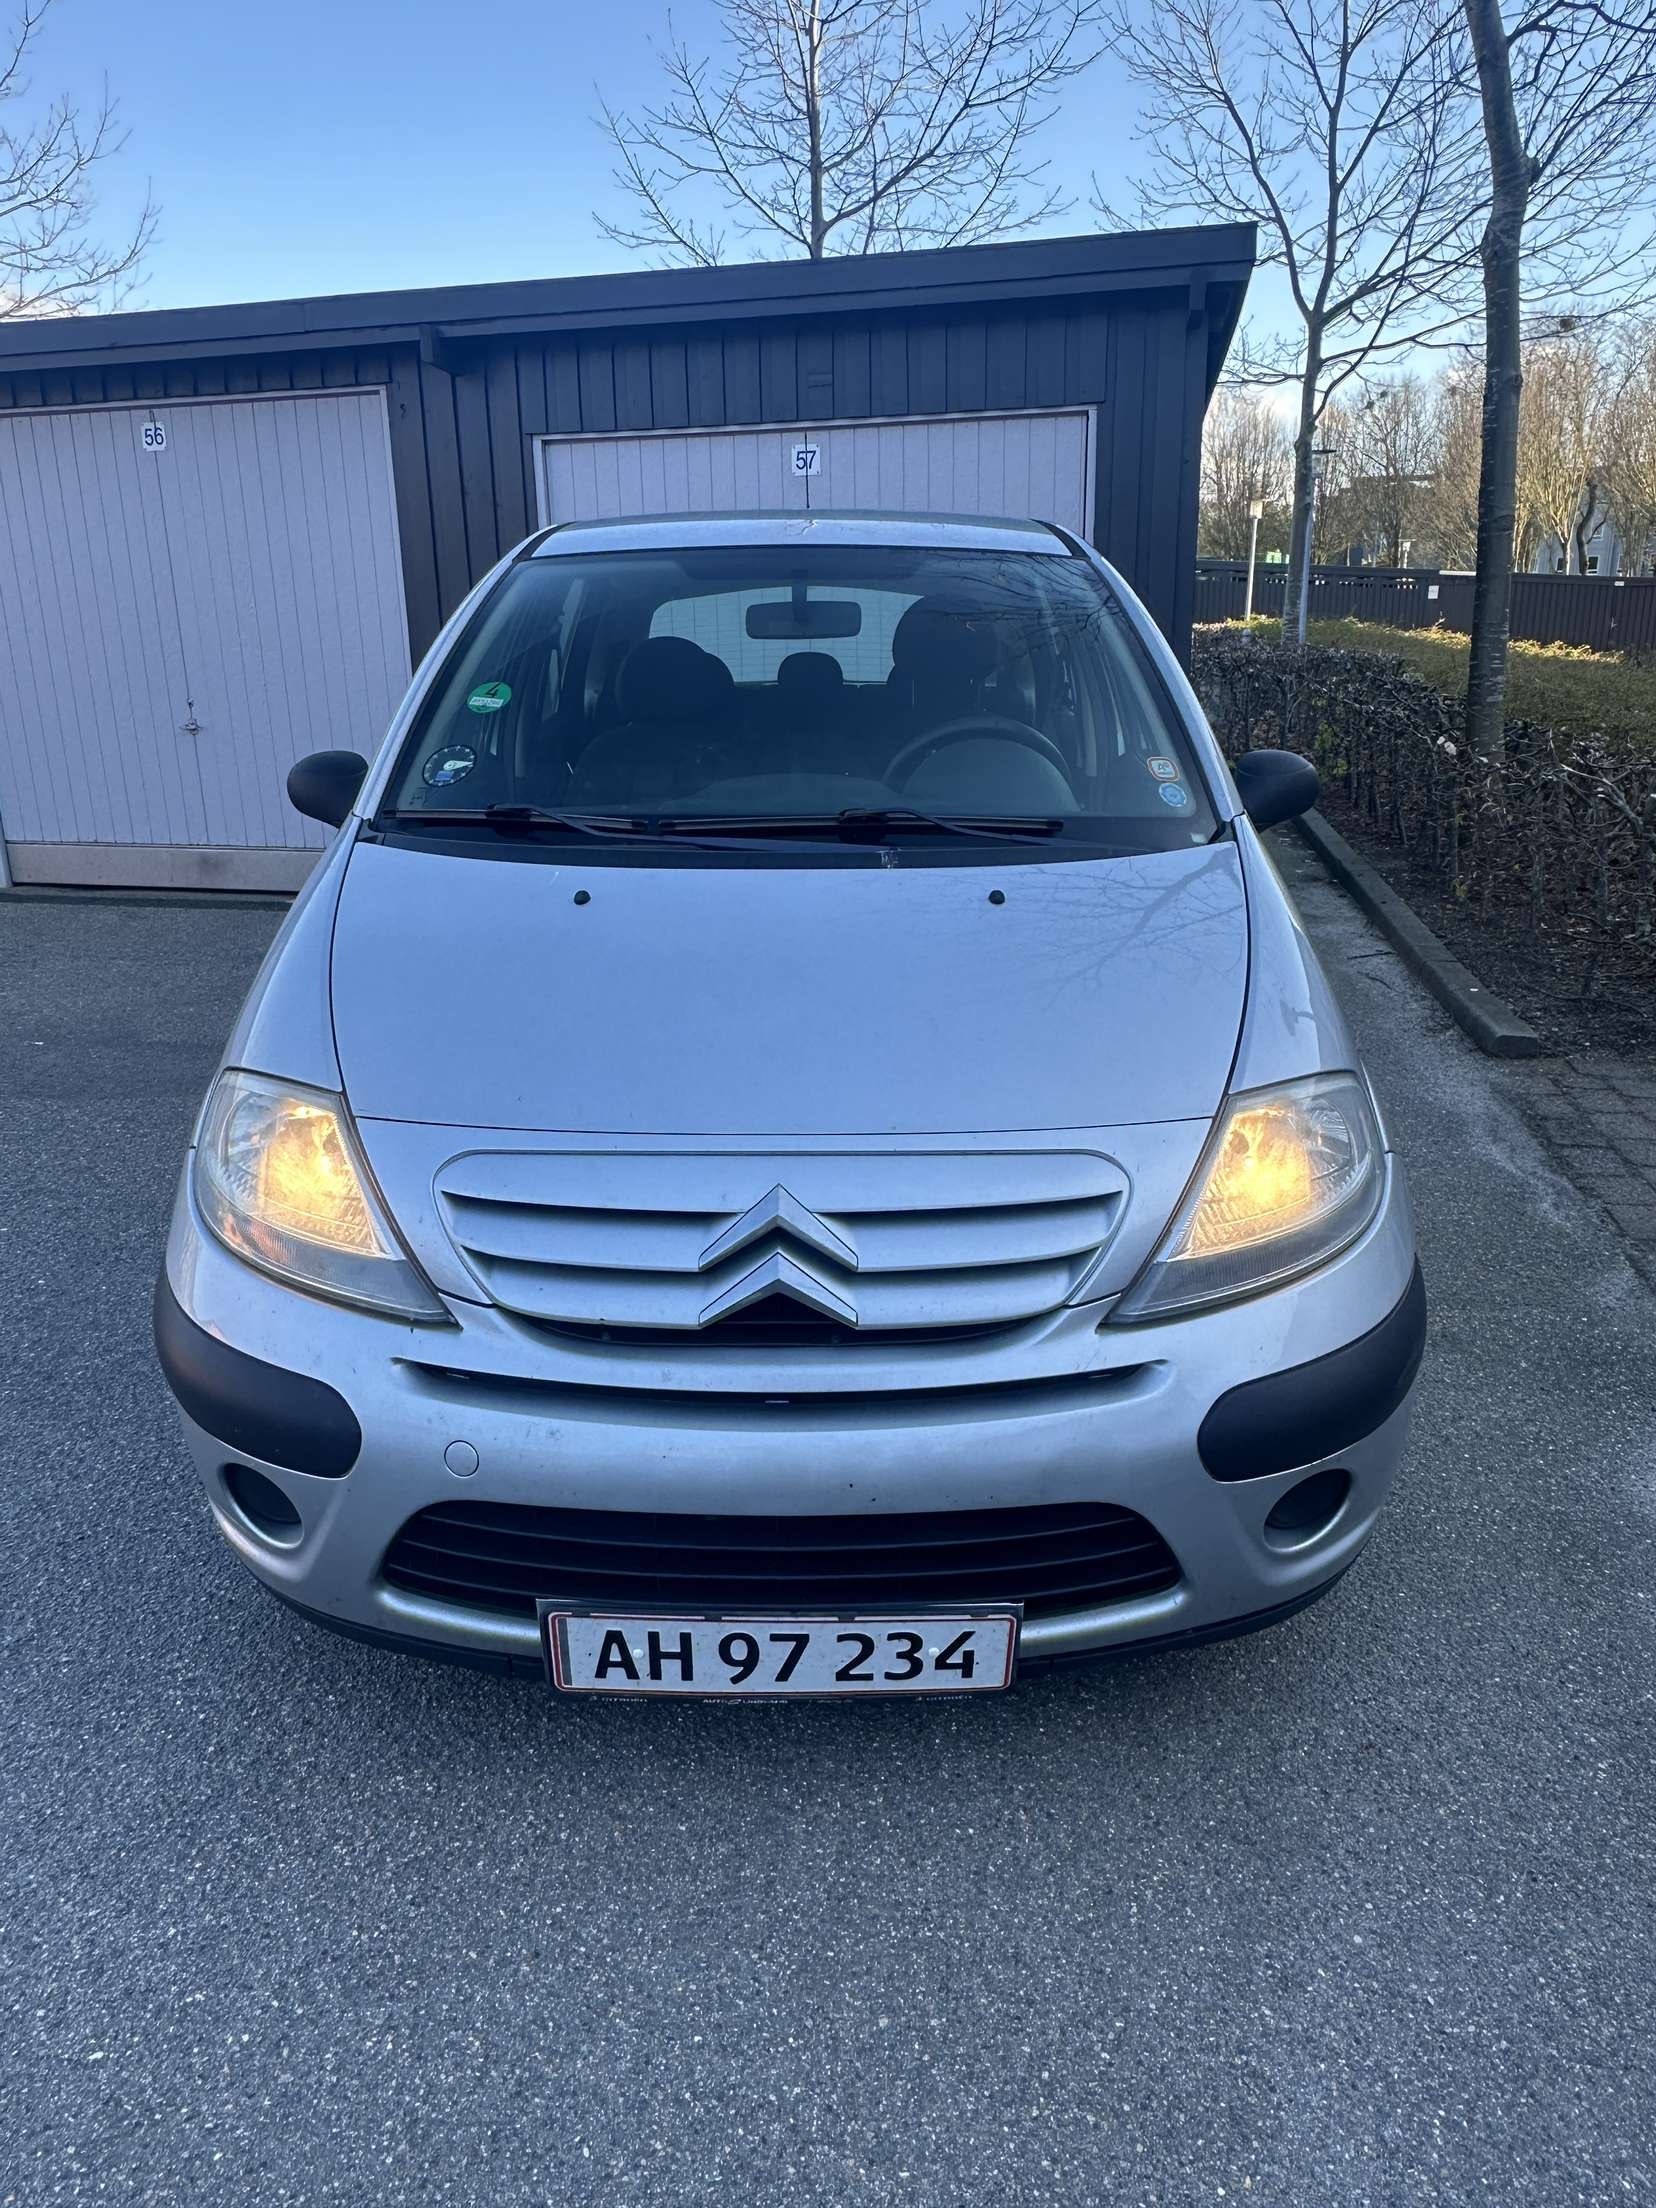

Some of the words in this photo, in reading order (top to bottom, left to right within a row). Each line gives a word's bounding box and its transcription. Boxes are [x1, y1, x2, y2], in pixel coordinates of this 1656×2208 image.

[145, 427, 164, 446] 56
[796, 450, 817, 470] 57
[485, 682, 501, 698] 4
[594, 1629, 694, 1682] AH
[718, 1632, 810, 1685] 97
[835, 1630, 977, 1682] 234
